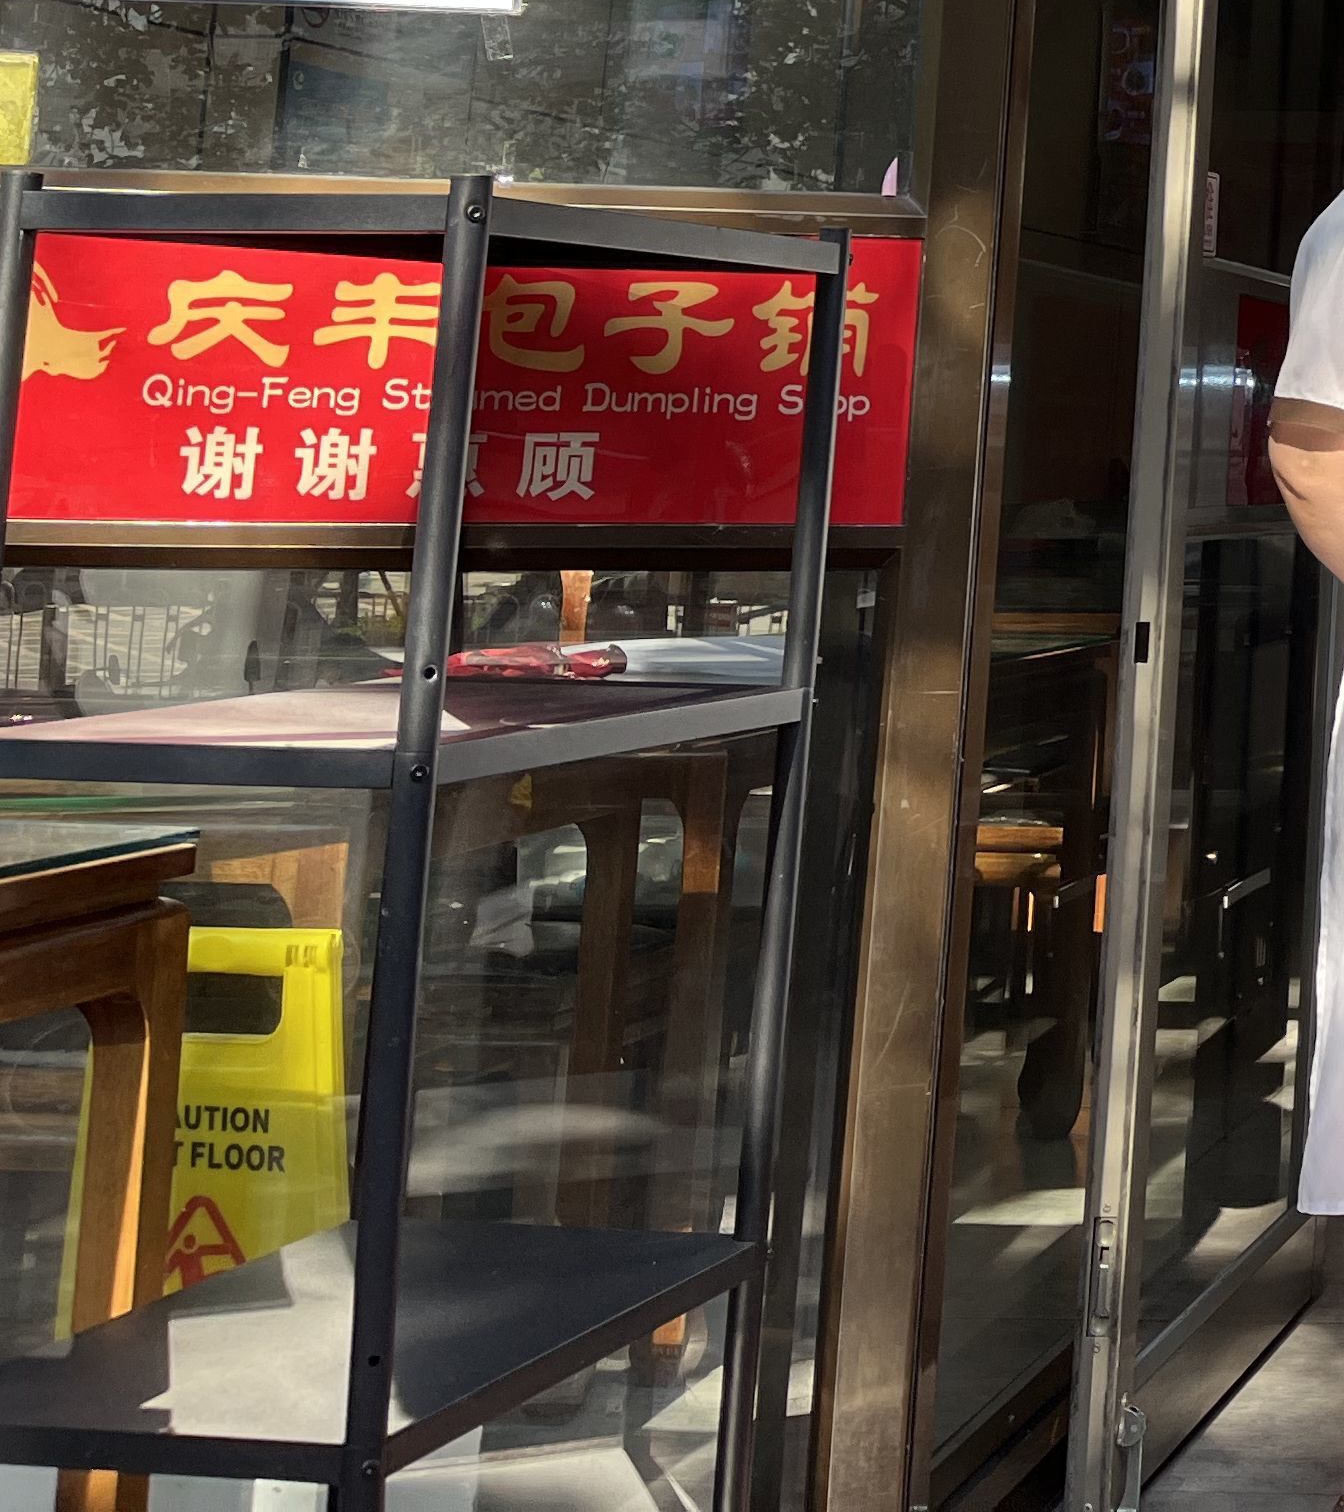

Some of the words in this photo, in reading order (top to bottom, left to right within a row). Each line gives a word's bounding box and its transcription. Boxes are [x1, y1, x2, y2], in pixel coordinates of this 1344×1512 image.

[147, 269, 880, 378] 庆丰包子铺
[141, 373, 360, 417] Qing-Feng
[382, 377, 561, 413] Stmed
[582, 382, 759, 420] Dumpling
[778, 384, 871, 422] Sop
[174, 1104, 270, 1134] UTION
[190, 1141, 285, 1173] FLOOR
